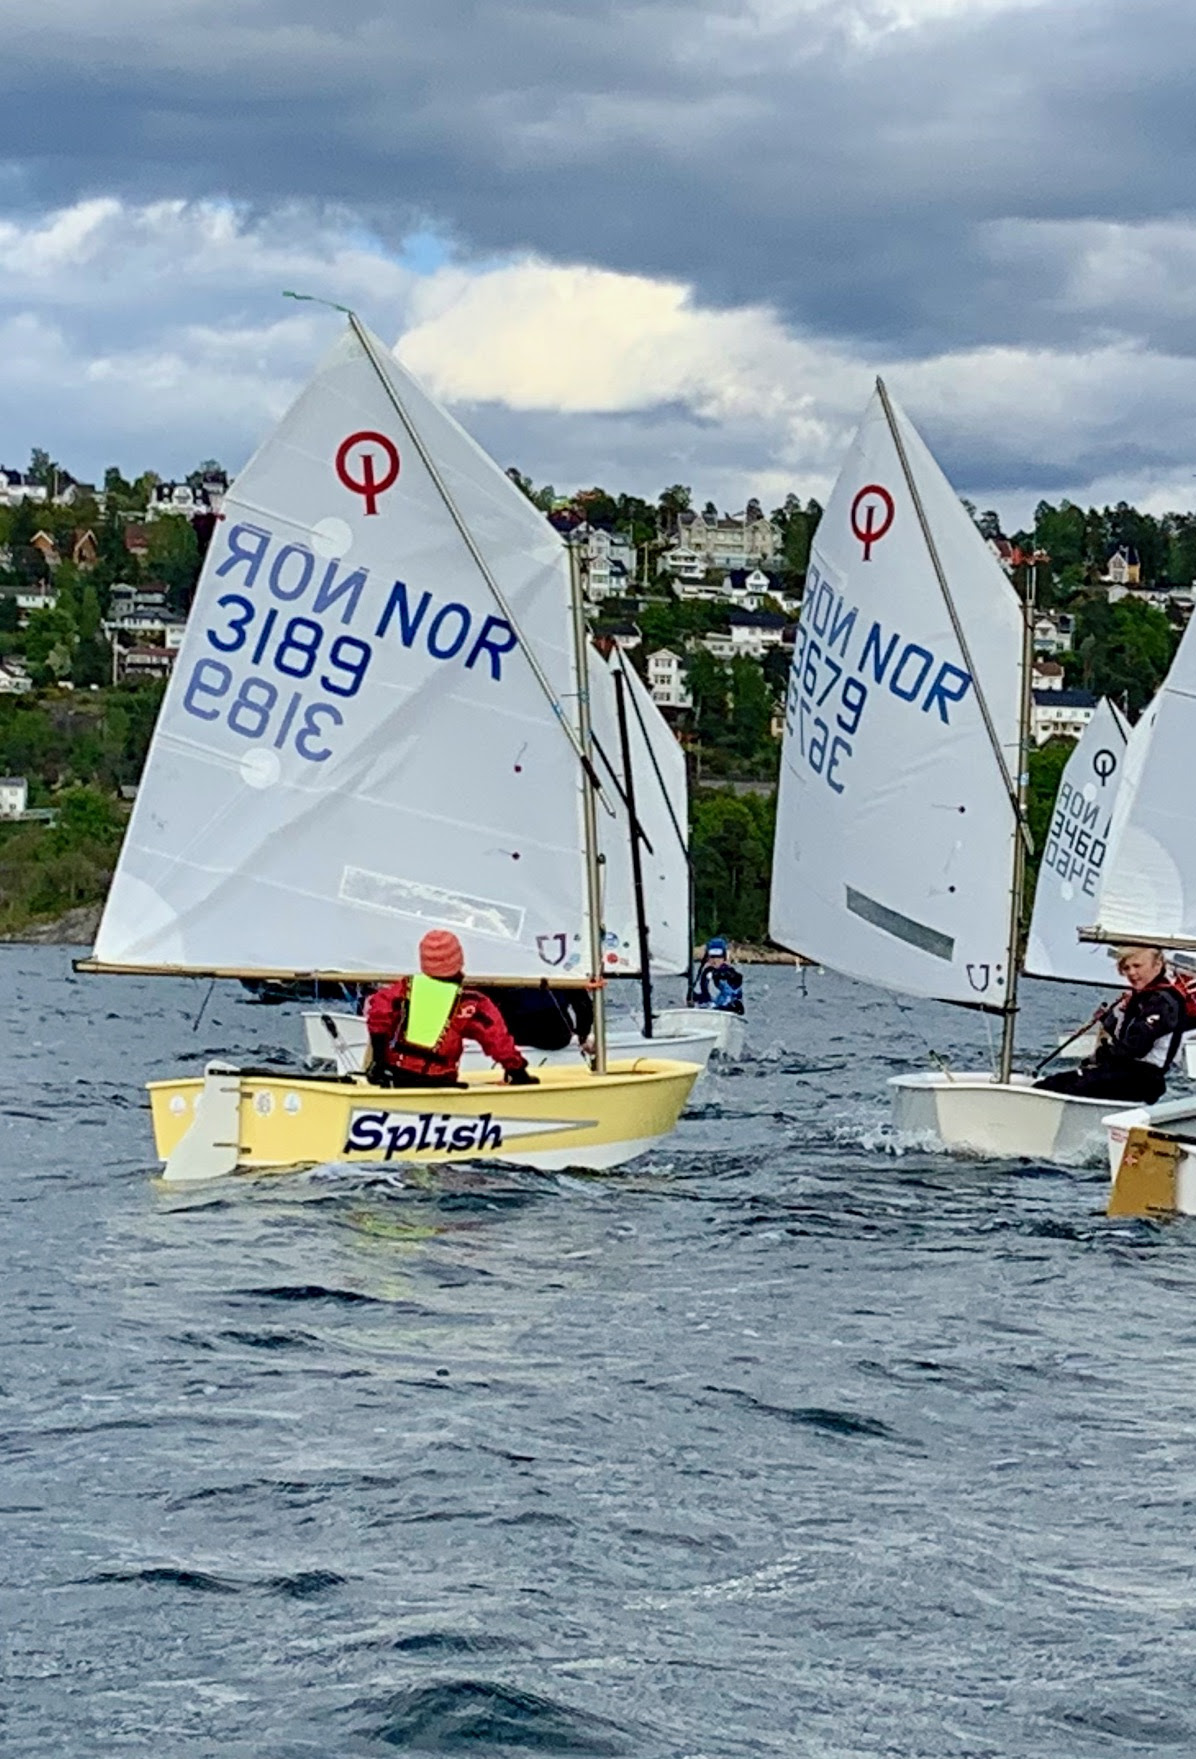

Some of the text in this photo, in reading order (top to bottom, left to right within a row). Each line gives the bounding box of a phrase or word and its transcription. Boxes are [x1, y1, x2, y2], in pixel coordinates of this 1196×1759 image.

[207, 594, 372, 697] 3189
[375, 581, 518, 681] NOR
[858, 620, 974, 725] NOR
[1050, 809, 1106, 868] 3460
[343, 1111, 503, 1160] Splish
